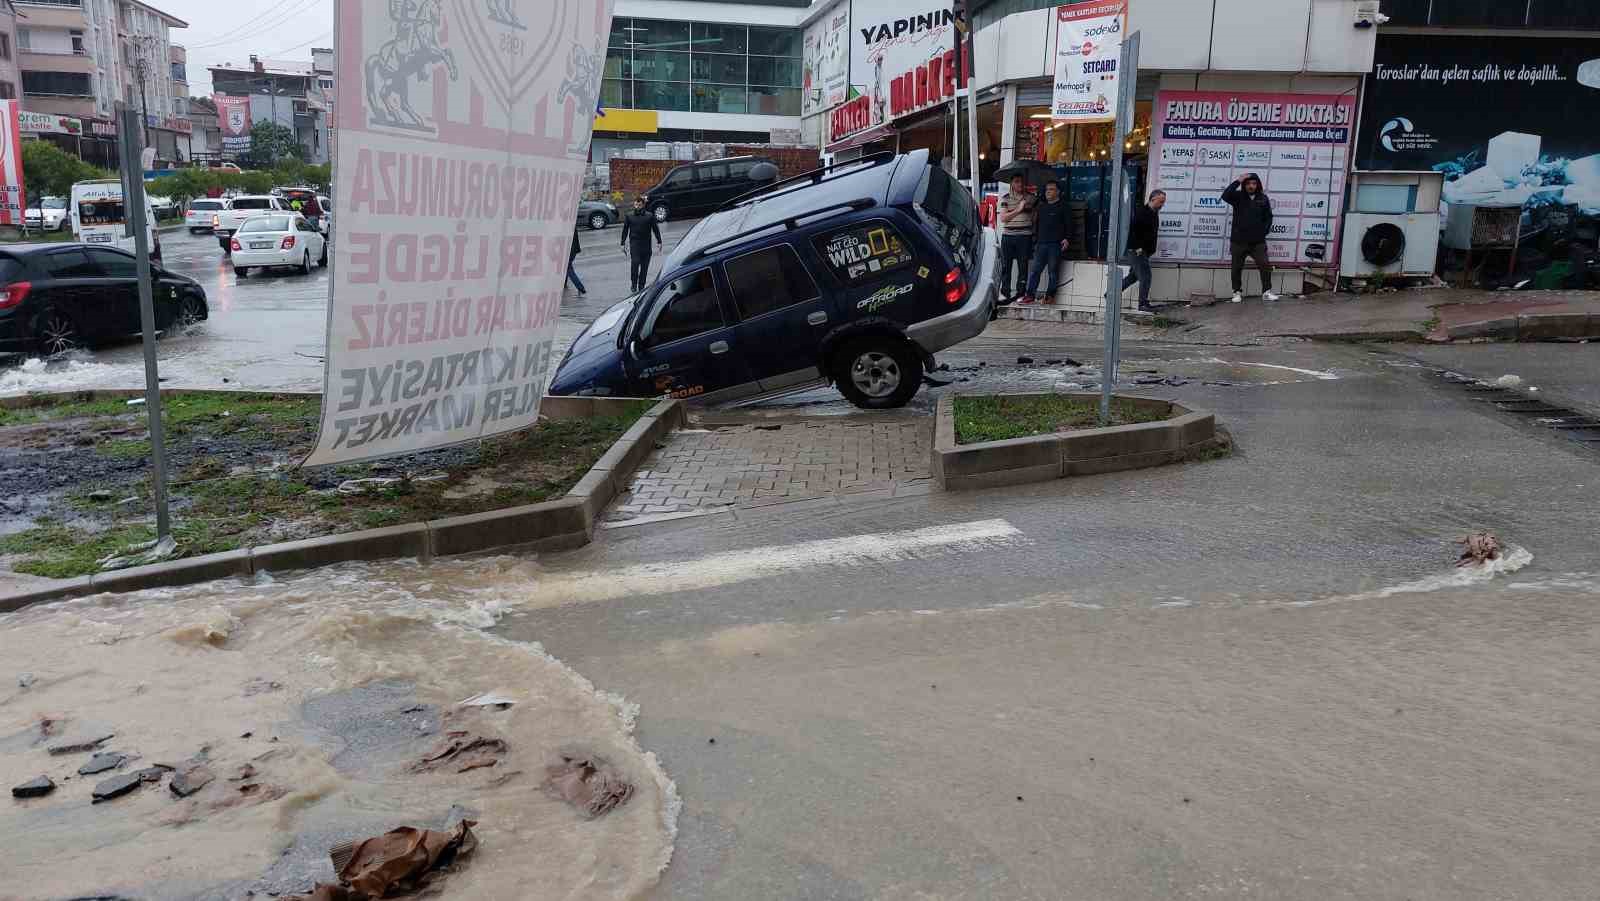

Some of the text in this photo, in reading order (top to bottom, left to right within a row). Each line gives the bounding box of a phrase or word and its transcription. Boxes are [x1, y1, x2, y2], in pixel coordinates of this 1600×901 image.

[1083, 60, 1117, 74] SETCARD
[1375, 64, 1438, 81] Toroslar'dan
[1441, 64, 1469, 86] gelen
[1471, 64, 1500, 82] saflık
[1503, 70, 1515, 80] ve
[1165, 97, 1350, 126] FATURA ÖDEME NOKTASI
[1234, 126, 1250, 137] Tüm
[1296, 128, 1324, 139] Burada
[827, 240, 843, 254] NAT
[843, 236, 859, 249] GEO
[828, 244, 871, 268] WILD
